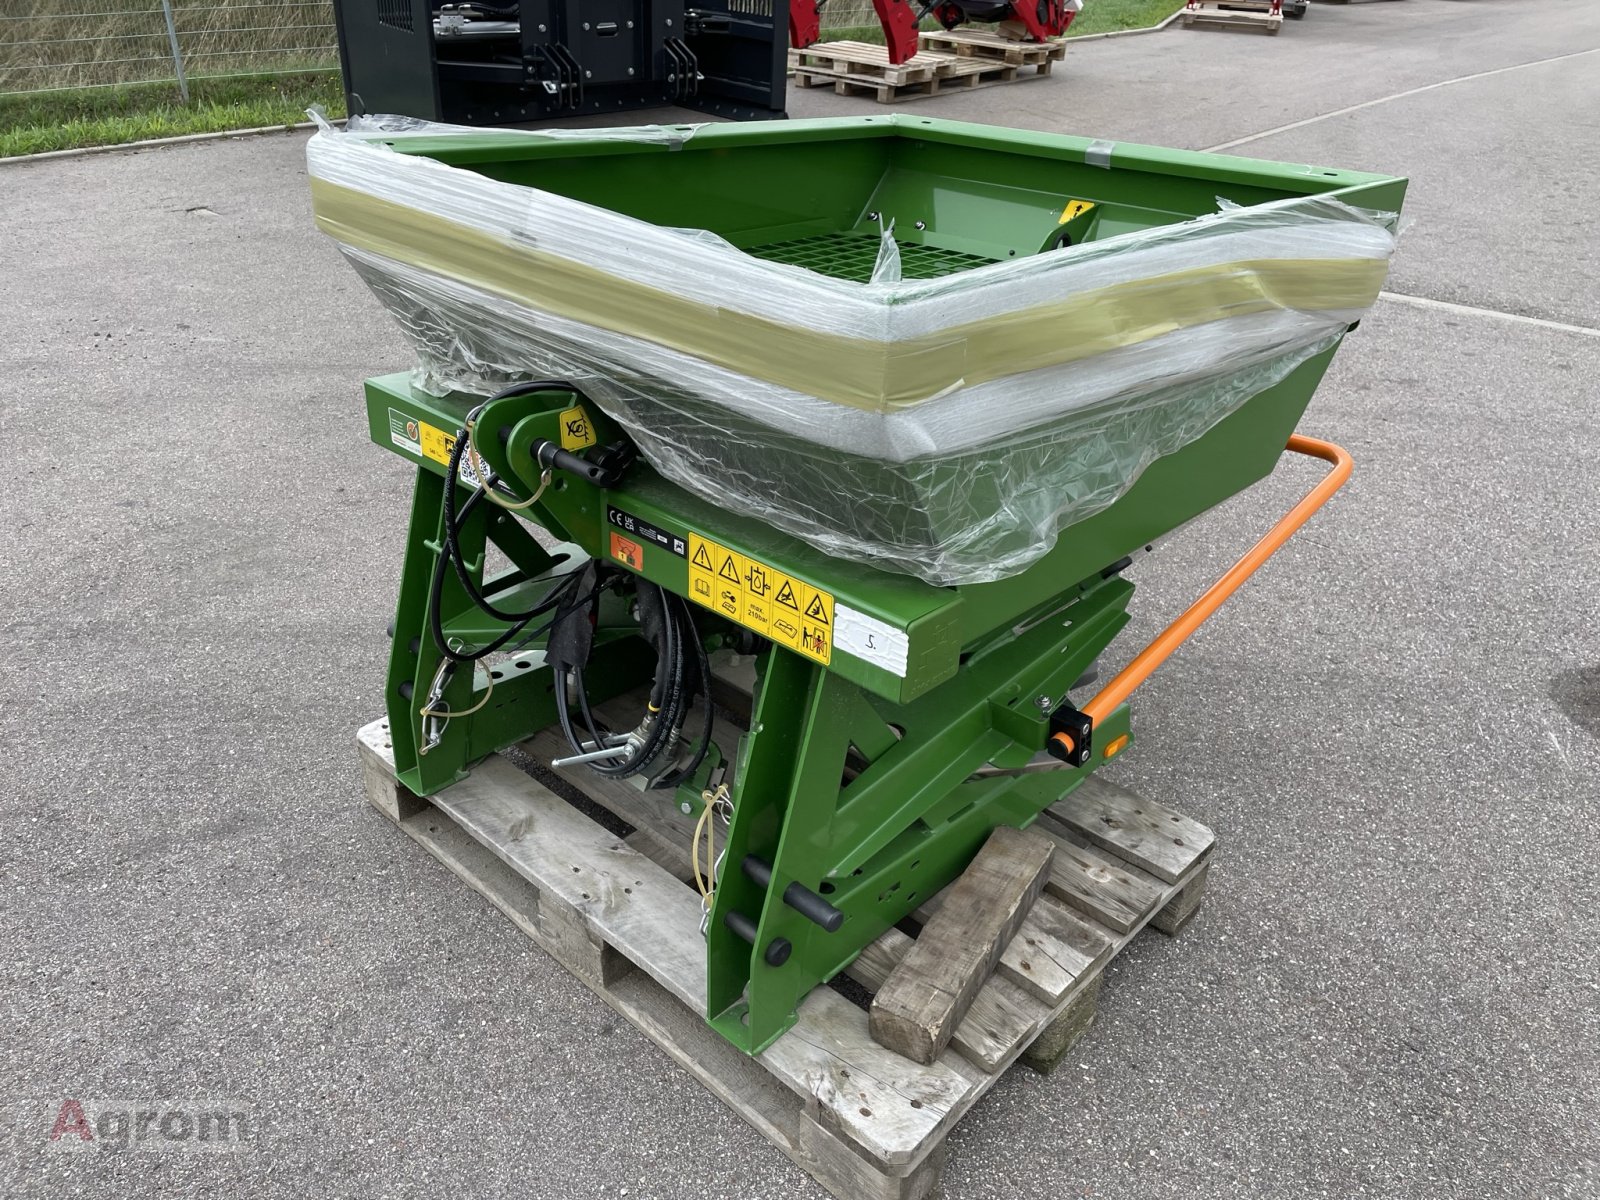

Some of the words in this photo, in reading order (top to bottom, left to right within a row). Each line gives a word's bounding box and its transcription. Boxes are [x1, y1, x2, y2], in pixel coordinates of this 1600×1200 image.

[609, 510, 622, 526] CE
[624, 515, 634, 525] UK
[624, 522, 635, 532] CA
[750, 603, 764, 614] max.
[747, 609, 768, 624] 210bar
